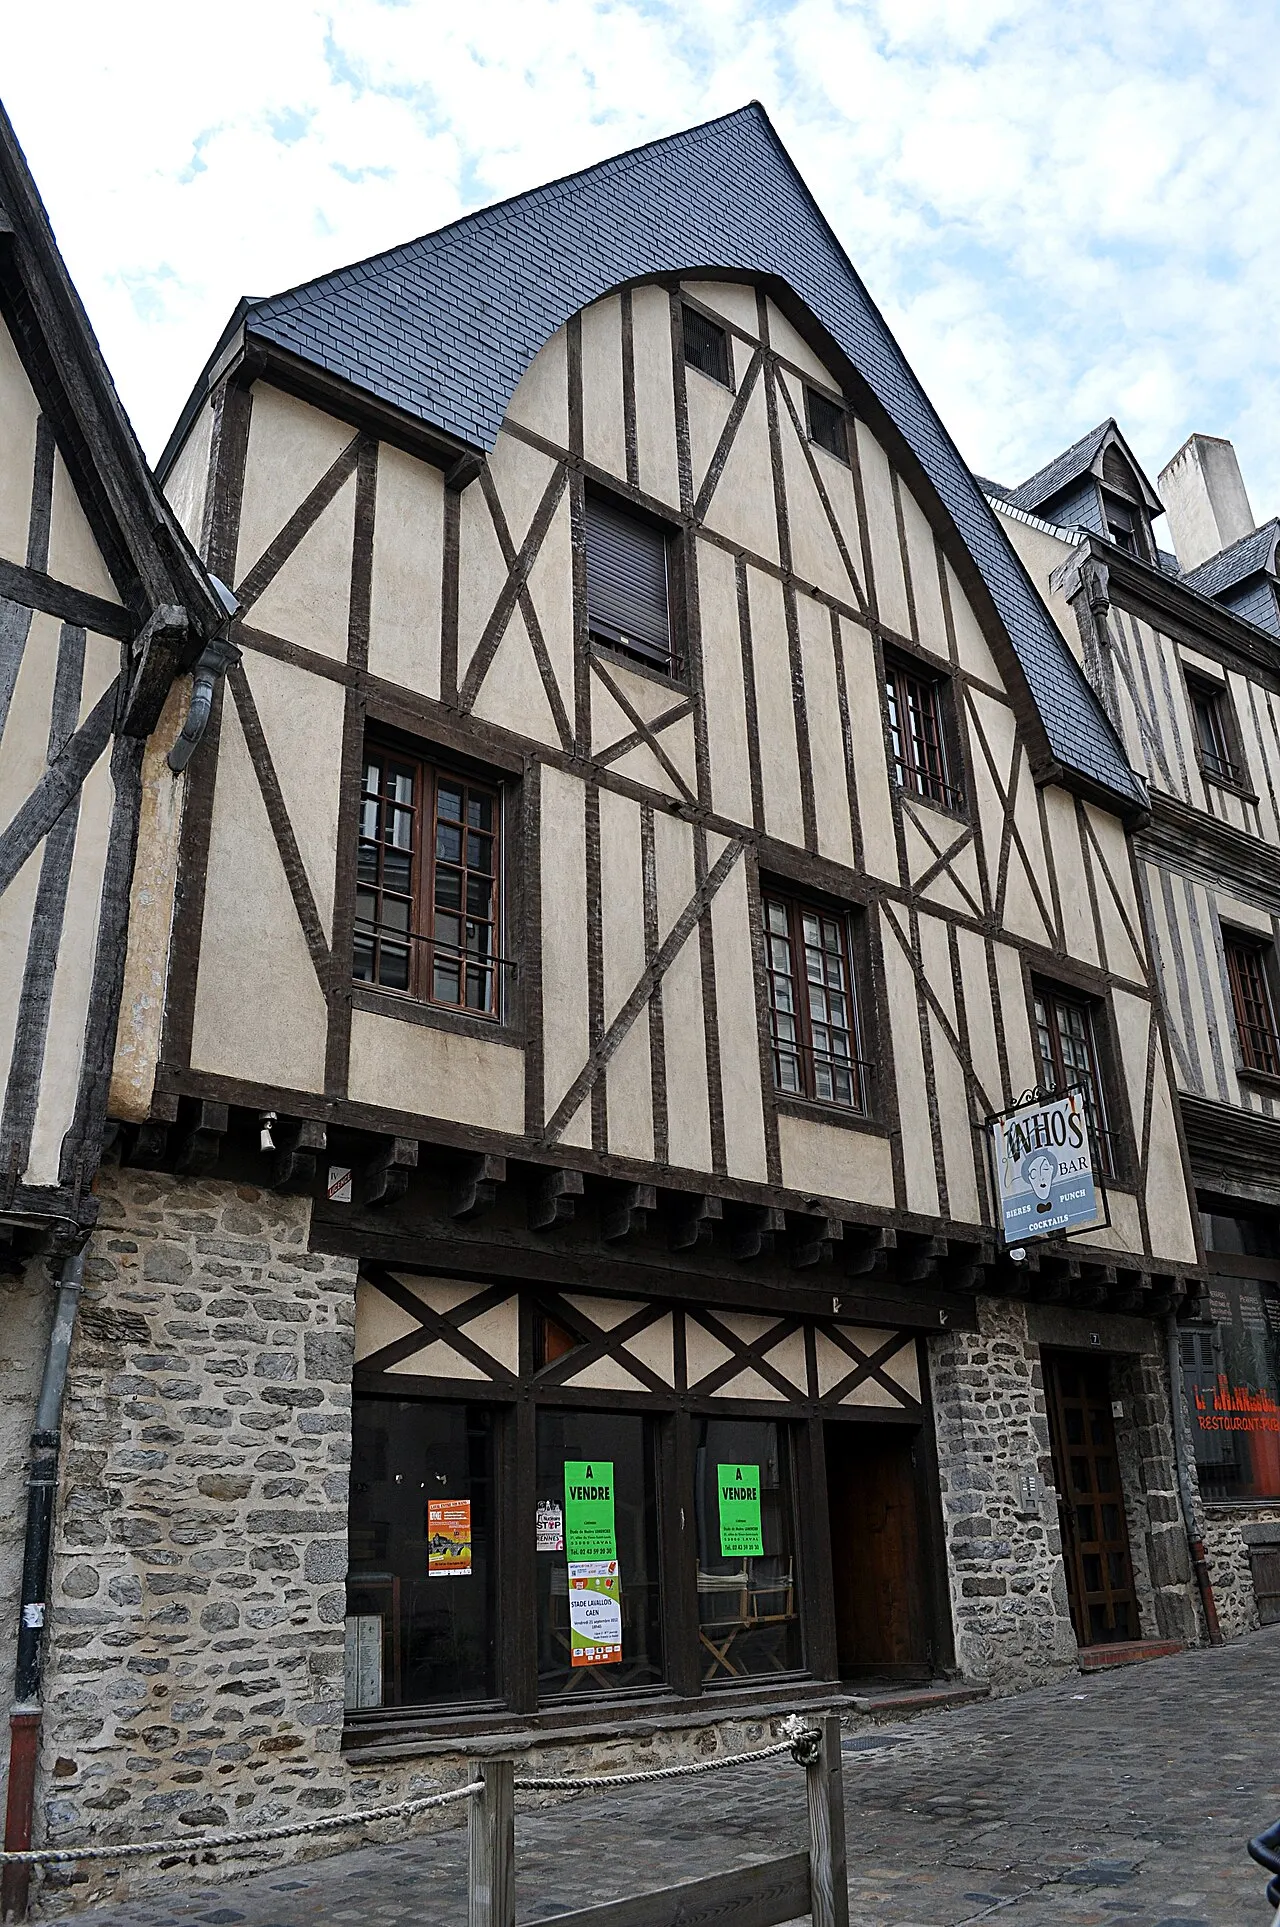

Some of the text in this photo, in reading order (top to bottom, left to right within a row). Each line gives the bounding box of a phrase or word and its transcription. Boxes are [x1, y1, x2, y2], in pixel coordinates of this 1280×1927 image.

[1004, 1104, 1083, 1162] WHO'S
[1059, 1157, 1088, 1175] BAR
[329, 1173, 352, 1196] LICENCE
[1059, 1189, 1086, 1203] PUNCH
[1006, 1205, 1031, 1219] BIERES
[1029, 1215, 1068, 1231] COCKTAILS
[586, 1465, 593, 1478] A
[736, 1468, 742, 1480] A
[569, 1486, 610, 1501] VENDRE
[722, 1487, 757, 1501] VENDRE
[571, 1598, 612, 1608] STADE LAVALLOIS
